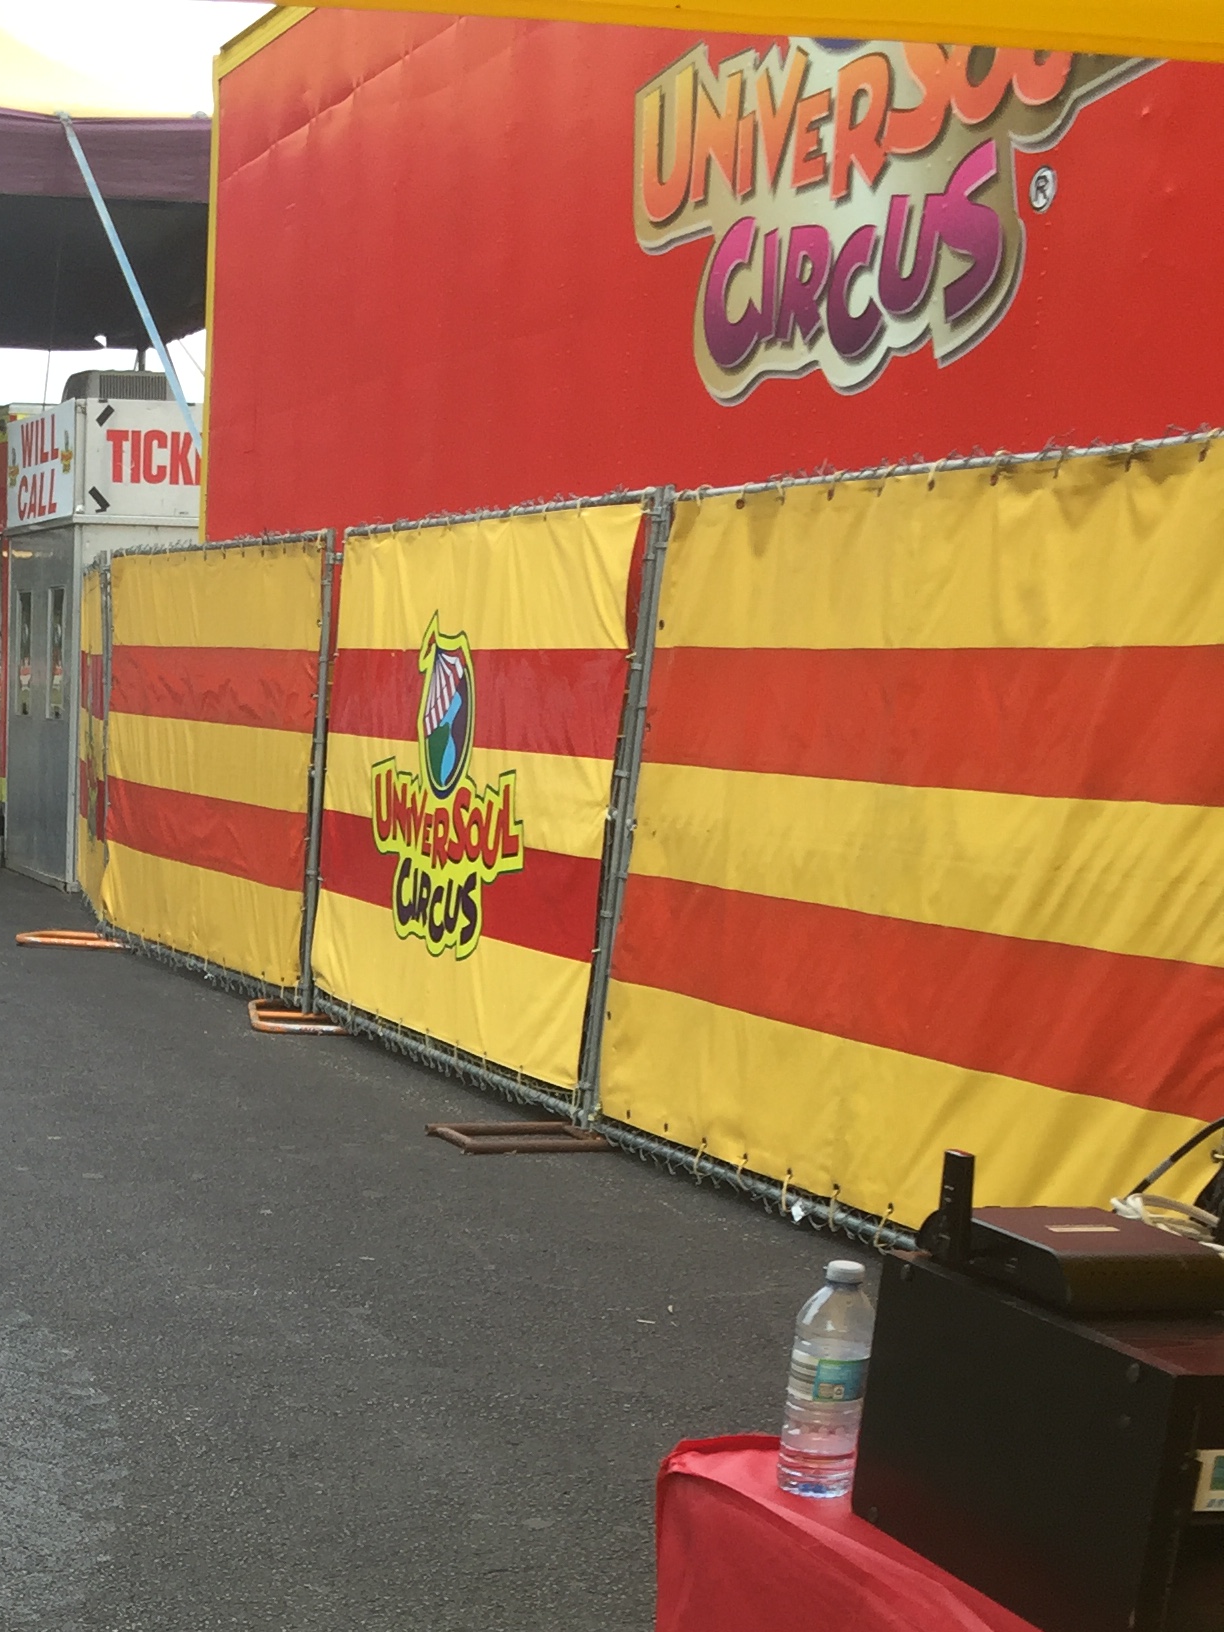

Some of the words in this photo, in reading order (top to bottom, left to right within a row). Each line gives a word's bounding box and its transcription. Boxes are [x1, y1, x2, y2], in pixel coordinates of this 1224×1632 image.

[702, 138, 1003, 369] CIRCUS
[20, 413, 59, 469] WILL
[106, 429, 201, 486] TICK
[17, 468, 58, 521] CALL
[374, 768, 520, 870] UNIVERSOUL
[396, 857, 478, 946] CIRCUS
